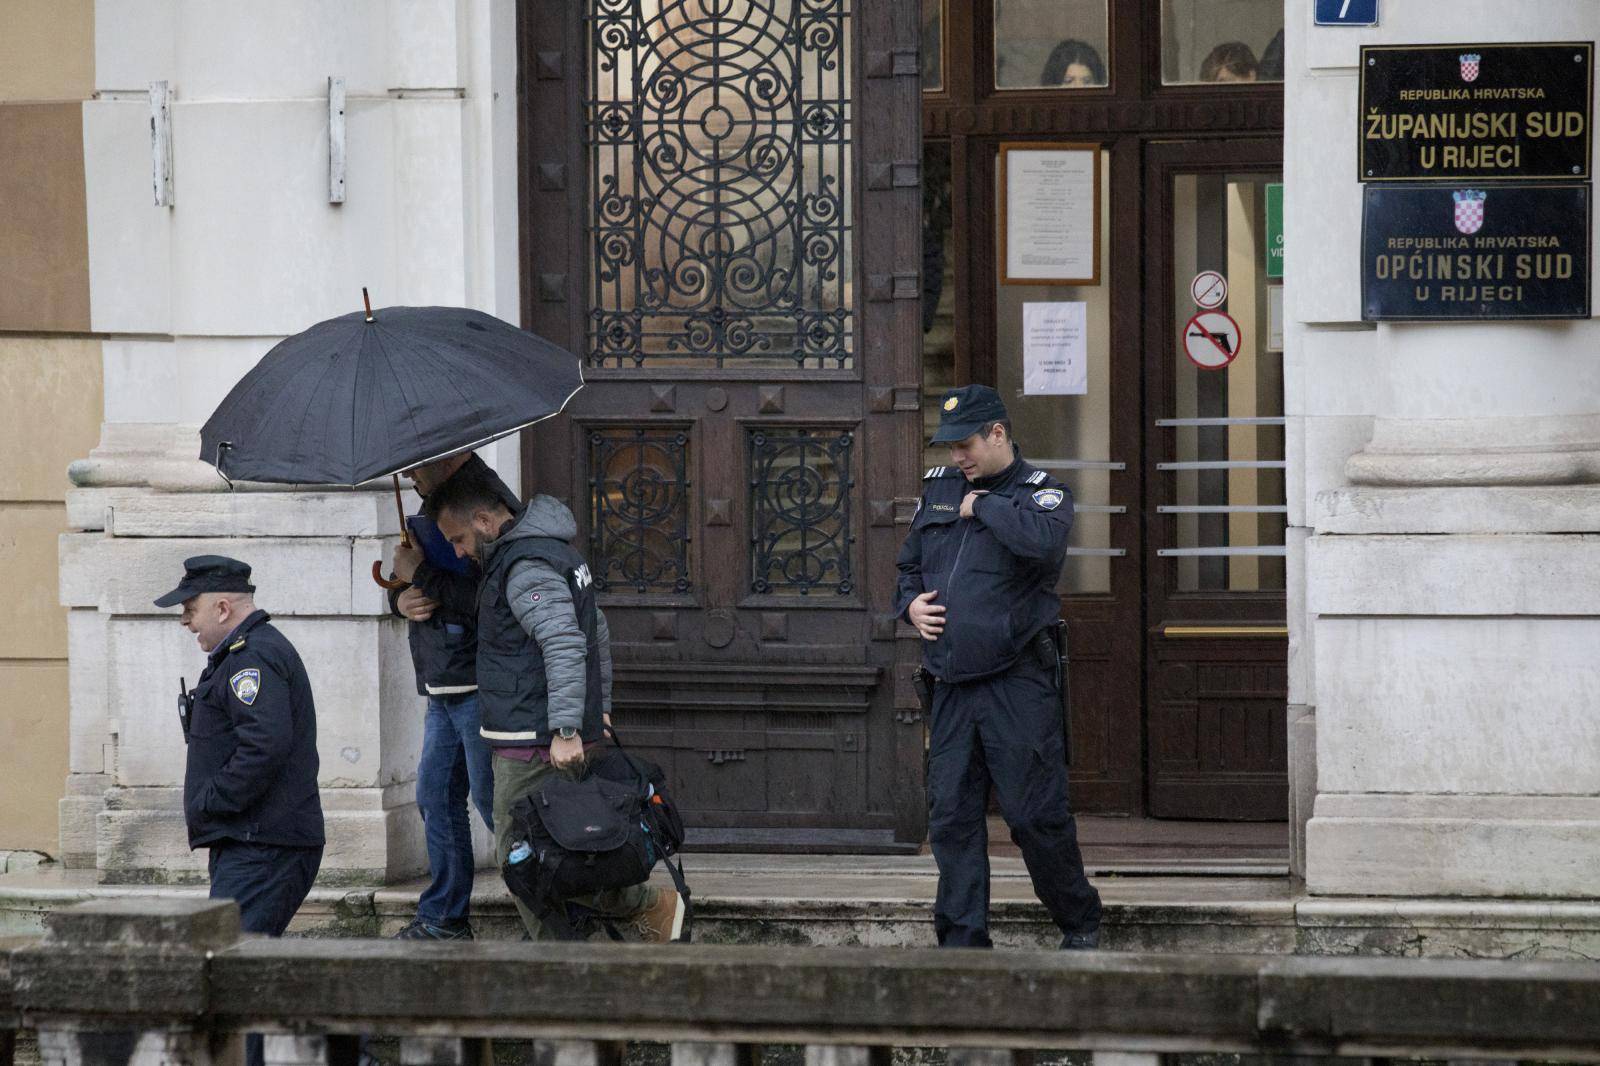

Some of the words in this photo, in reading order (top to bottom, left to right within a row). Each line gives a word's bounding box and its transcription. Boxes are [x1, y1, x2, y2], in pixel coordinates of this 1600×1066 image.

[1400, 89, 1470, 100] REPUBLIKA
[1474, 88, 1545, 99] HRVATSKA
[1366, 107, 1516, 139] ŽUPANIJSKI
[1526, 112, 1584, 138] SUD
[1421, 146, 1435, 168] U
[1443, 145, 1520, 168] RIJECI
[1388, 237, 1470, 249] REPUBLIKA
[1475, 236, 1560, 248] HRVATSKA
[1376, 249, 1503, 280] OPĆINSKI
[1516, 254, 1573, 279] SUD
[1416, 286, 1430, 301] U
[1441, 286, 1523, 301] RIJECI
